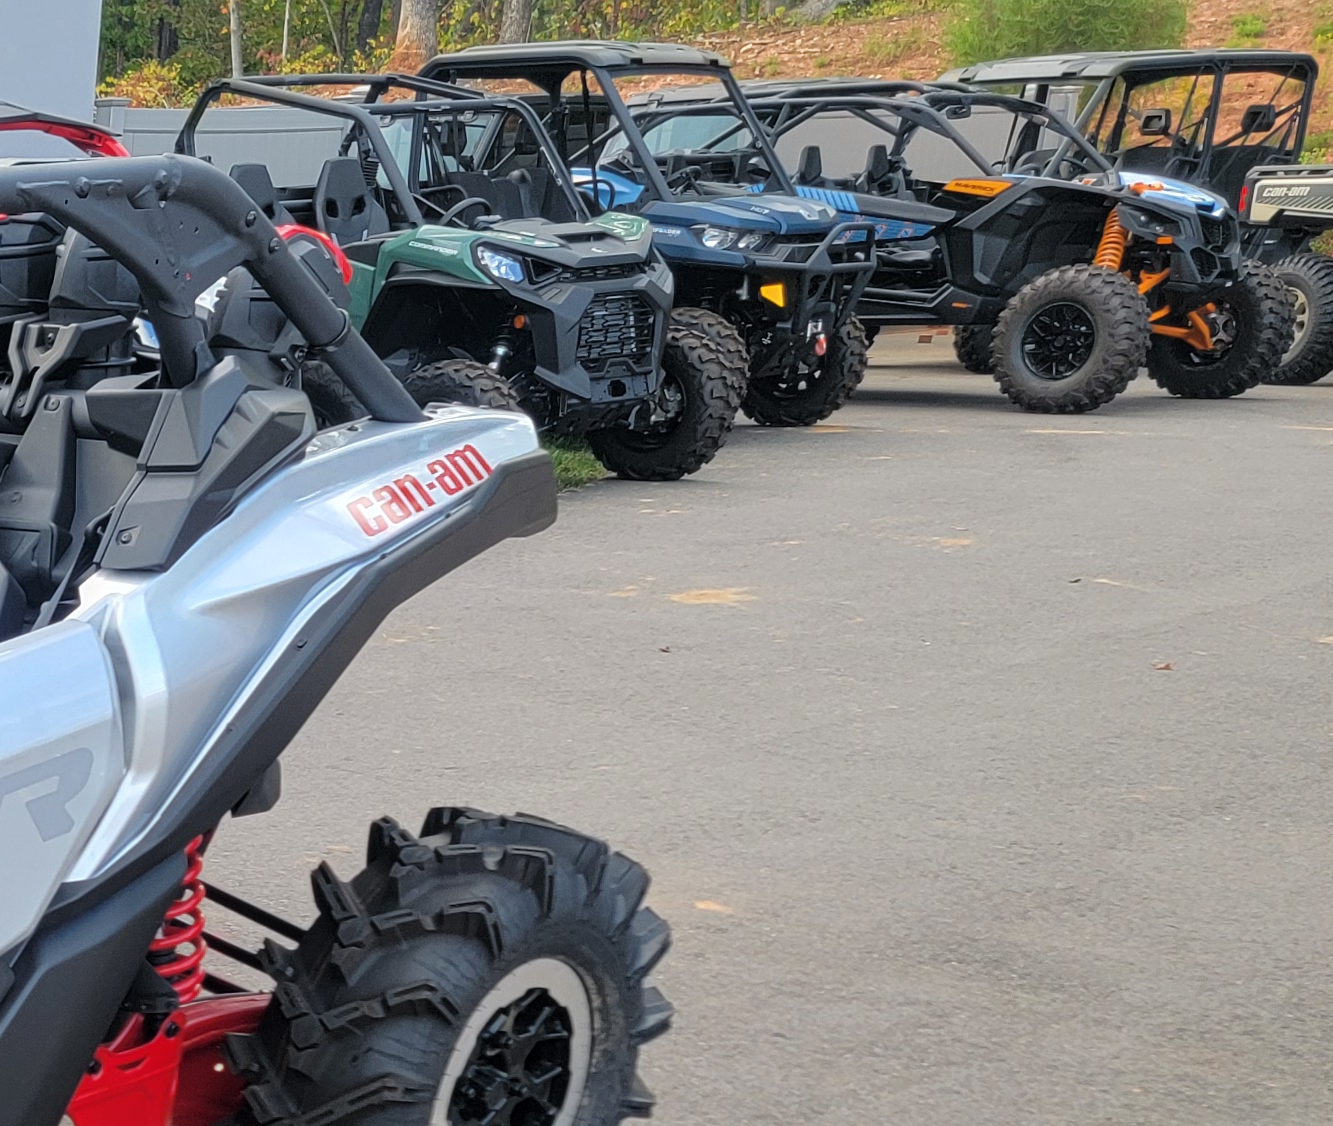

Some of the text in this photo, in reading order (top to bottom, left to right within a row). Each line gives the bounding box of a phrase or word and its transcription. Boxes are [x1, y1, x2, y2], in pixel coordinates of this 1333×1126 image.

[1262, 186, 1311, 197] can-am
[409, 240, 459, 256] COMMANDER
[346, 444, 493, 537] can-am
